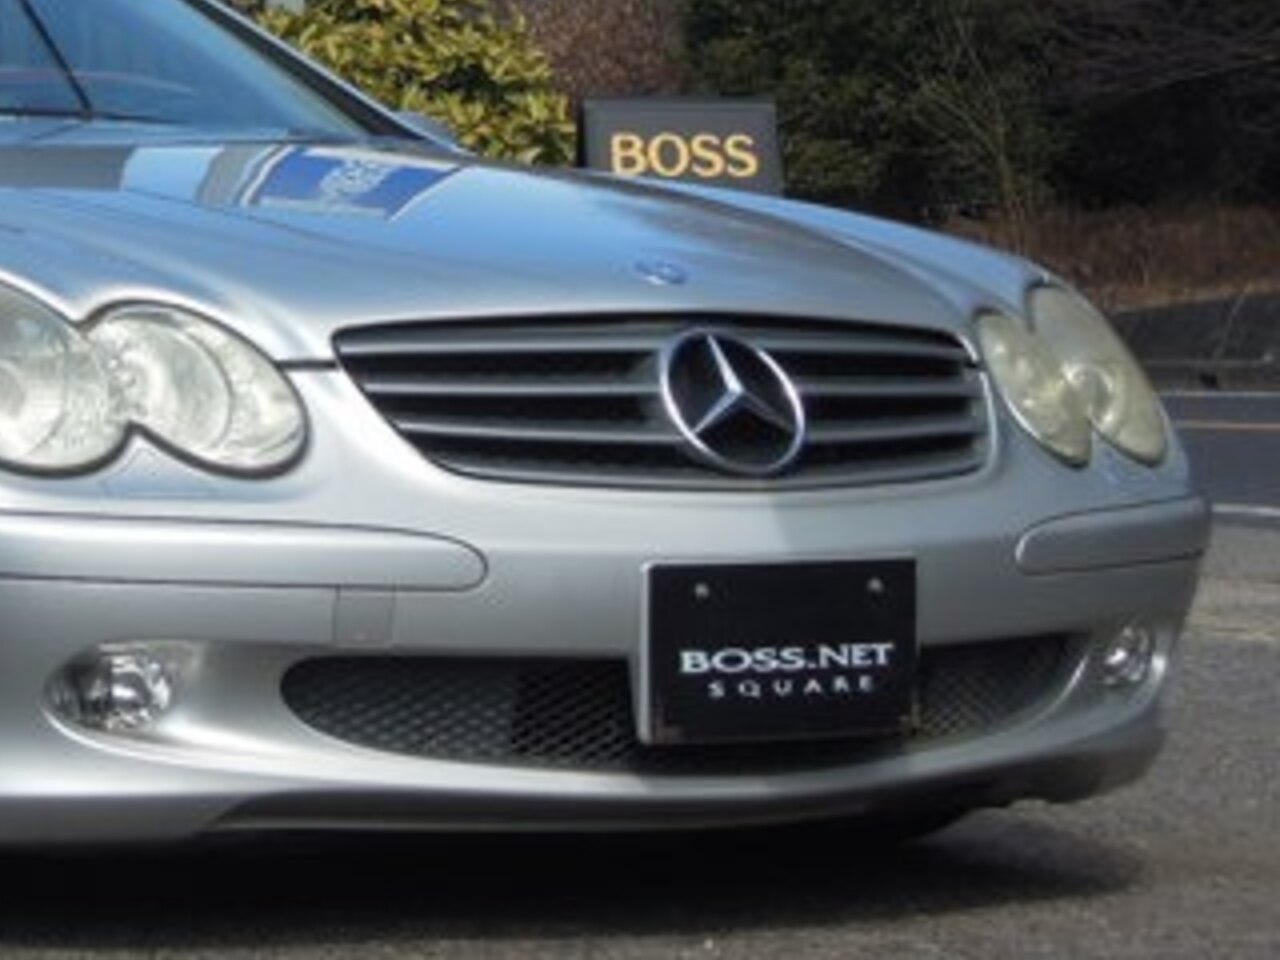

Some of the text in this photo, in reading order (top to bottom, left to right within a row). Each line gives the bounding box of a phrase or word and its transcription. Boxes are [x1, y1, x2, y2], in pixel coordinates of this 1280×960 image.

[610, 132, 760, 177] BOSS
[679, 642, 895, 674] BOSS.NET
[708, 674, 875, 699] SQUARE
